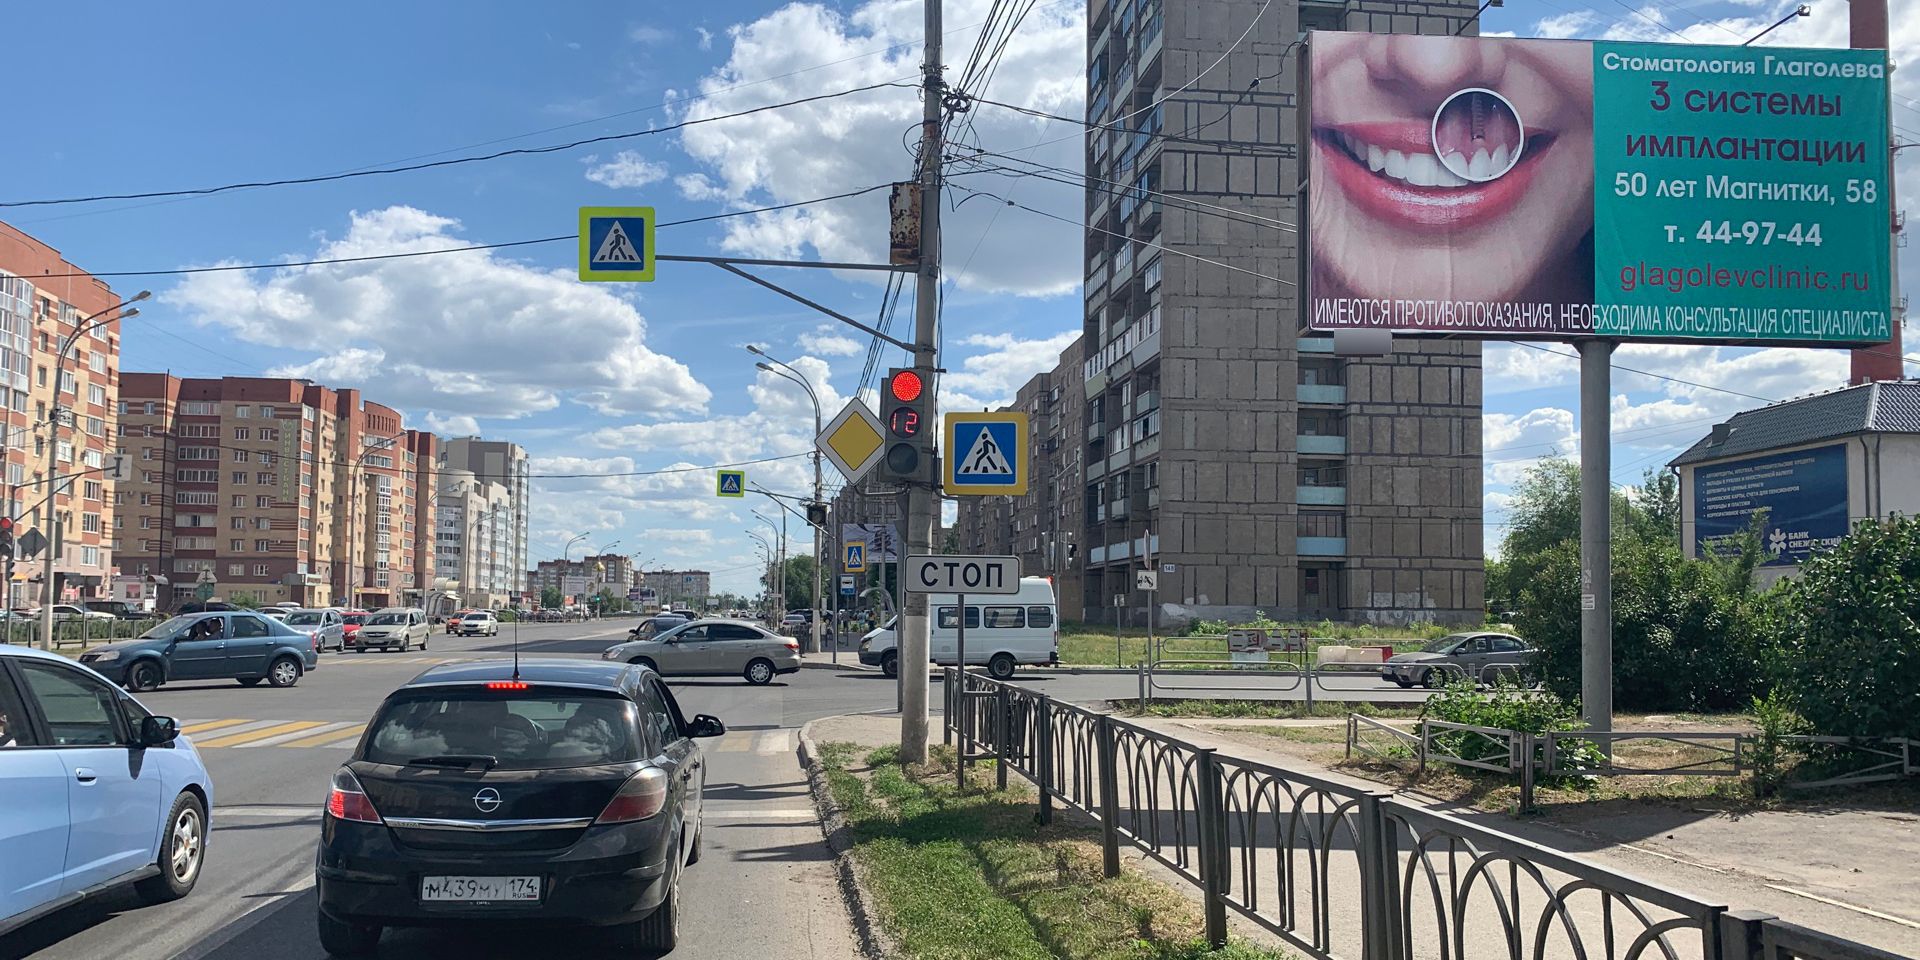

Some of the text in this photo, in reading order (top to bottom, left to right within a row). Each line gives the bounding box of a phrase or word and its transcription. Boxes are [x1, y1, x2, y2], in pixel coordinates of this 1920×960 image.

[1602, 52, 1885, 79] Стоматология Глаголева
[1649, 80, 1842, 117] 3 системы
[1625, 134, 1867, 167] имплантации
[1614, 172, 1878, 206] 50 лет Магнитки, 58
[1663, 220, 1823, 247] т. 44-97-44
[1619, 260, 1870, 293] glagolevclinic.ru
[1314, 298, 1889, 340] ИМЕЮТСЯ ПРОТИВОПОКАЗАНИЯ, НЕОБХОДИМА КОНСУЛЬТАЦИЯ СПЕЦИАЛИСТА
[893, 412, 918, 433] 12
[1788, 531, 1809, 540] БАНК
[920, 561, 1003, 588] СТОП
[509, 878, 535, 893] 174
